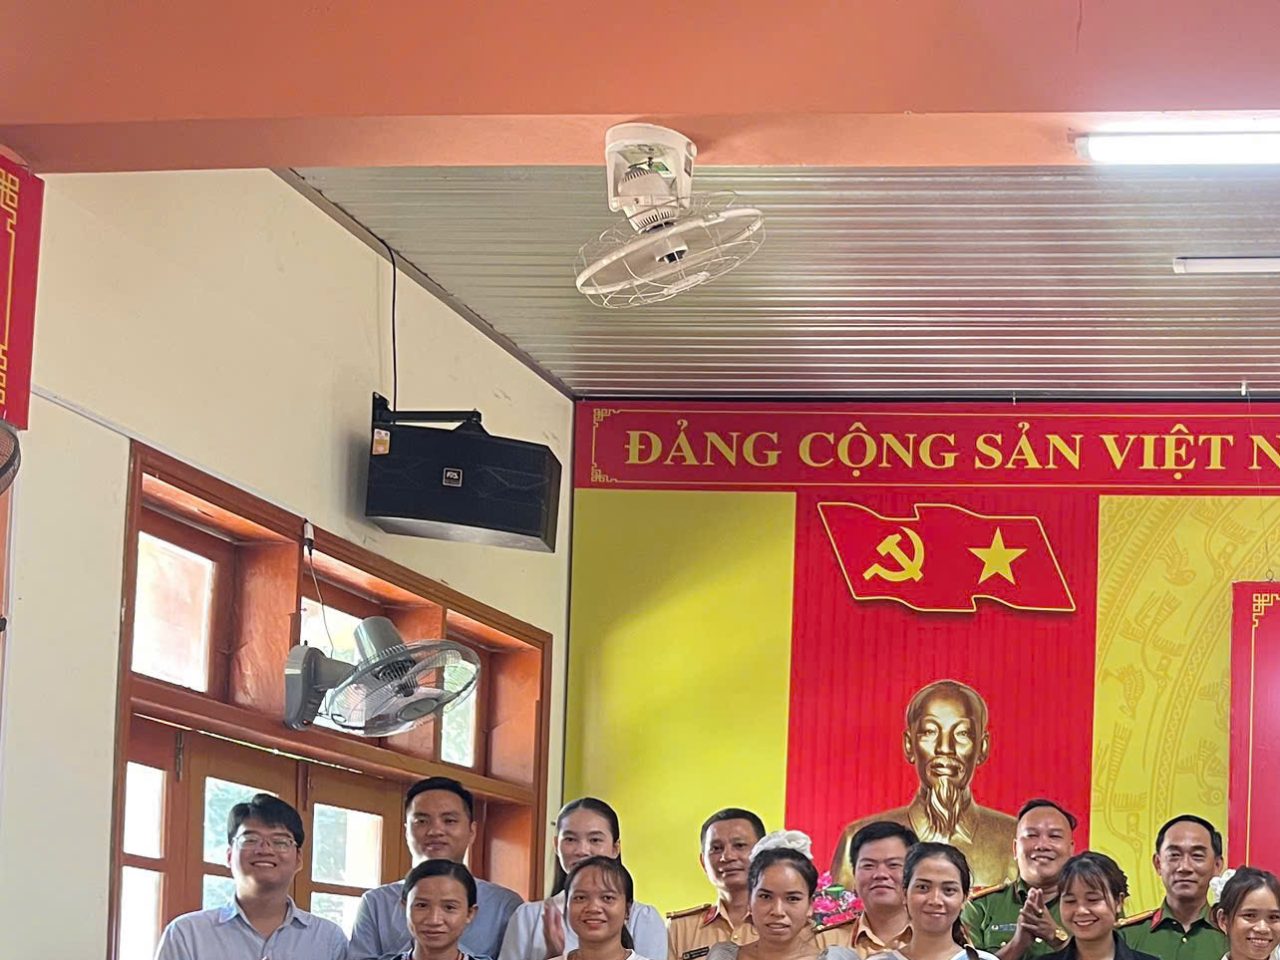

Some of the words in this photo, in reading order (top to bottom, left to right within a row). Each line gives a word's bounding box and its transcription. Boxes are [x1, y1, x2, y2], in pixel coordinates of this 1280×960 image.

[624, 419, 781, 468] ĐẢNG
[799, 422, 959, 478] CỘNG
[974, 421, 1082, 472] SẢN
[1098, 424, 1234, 480] VIỆT
